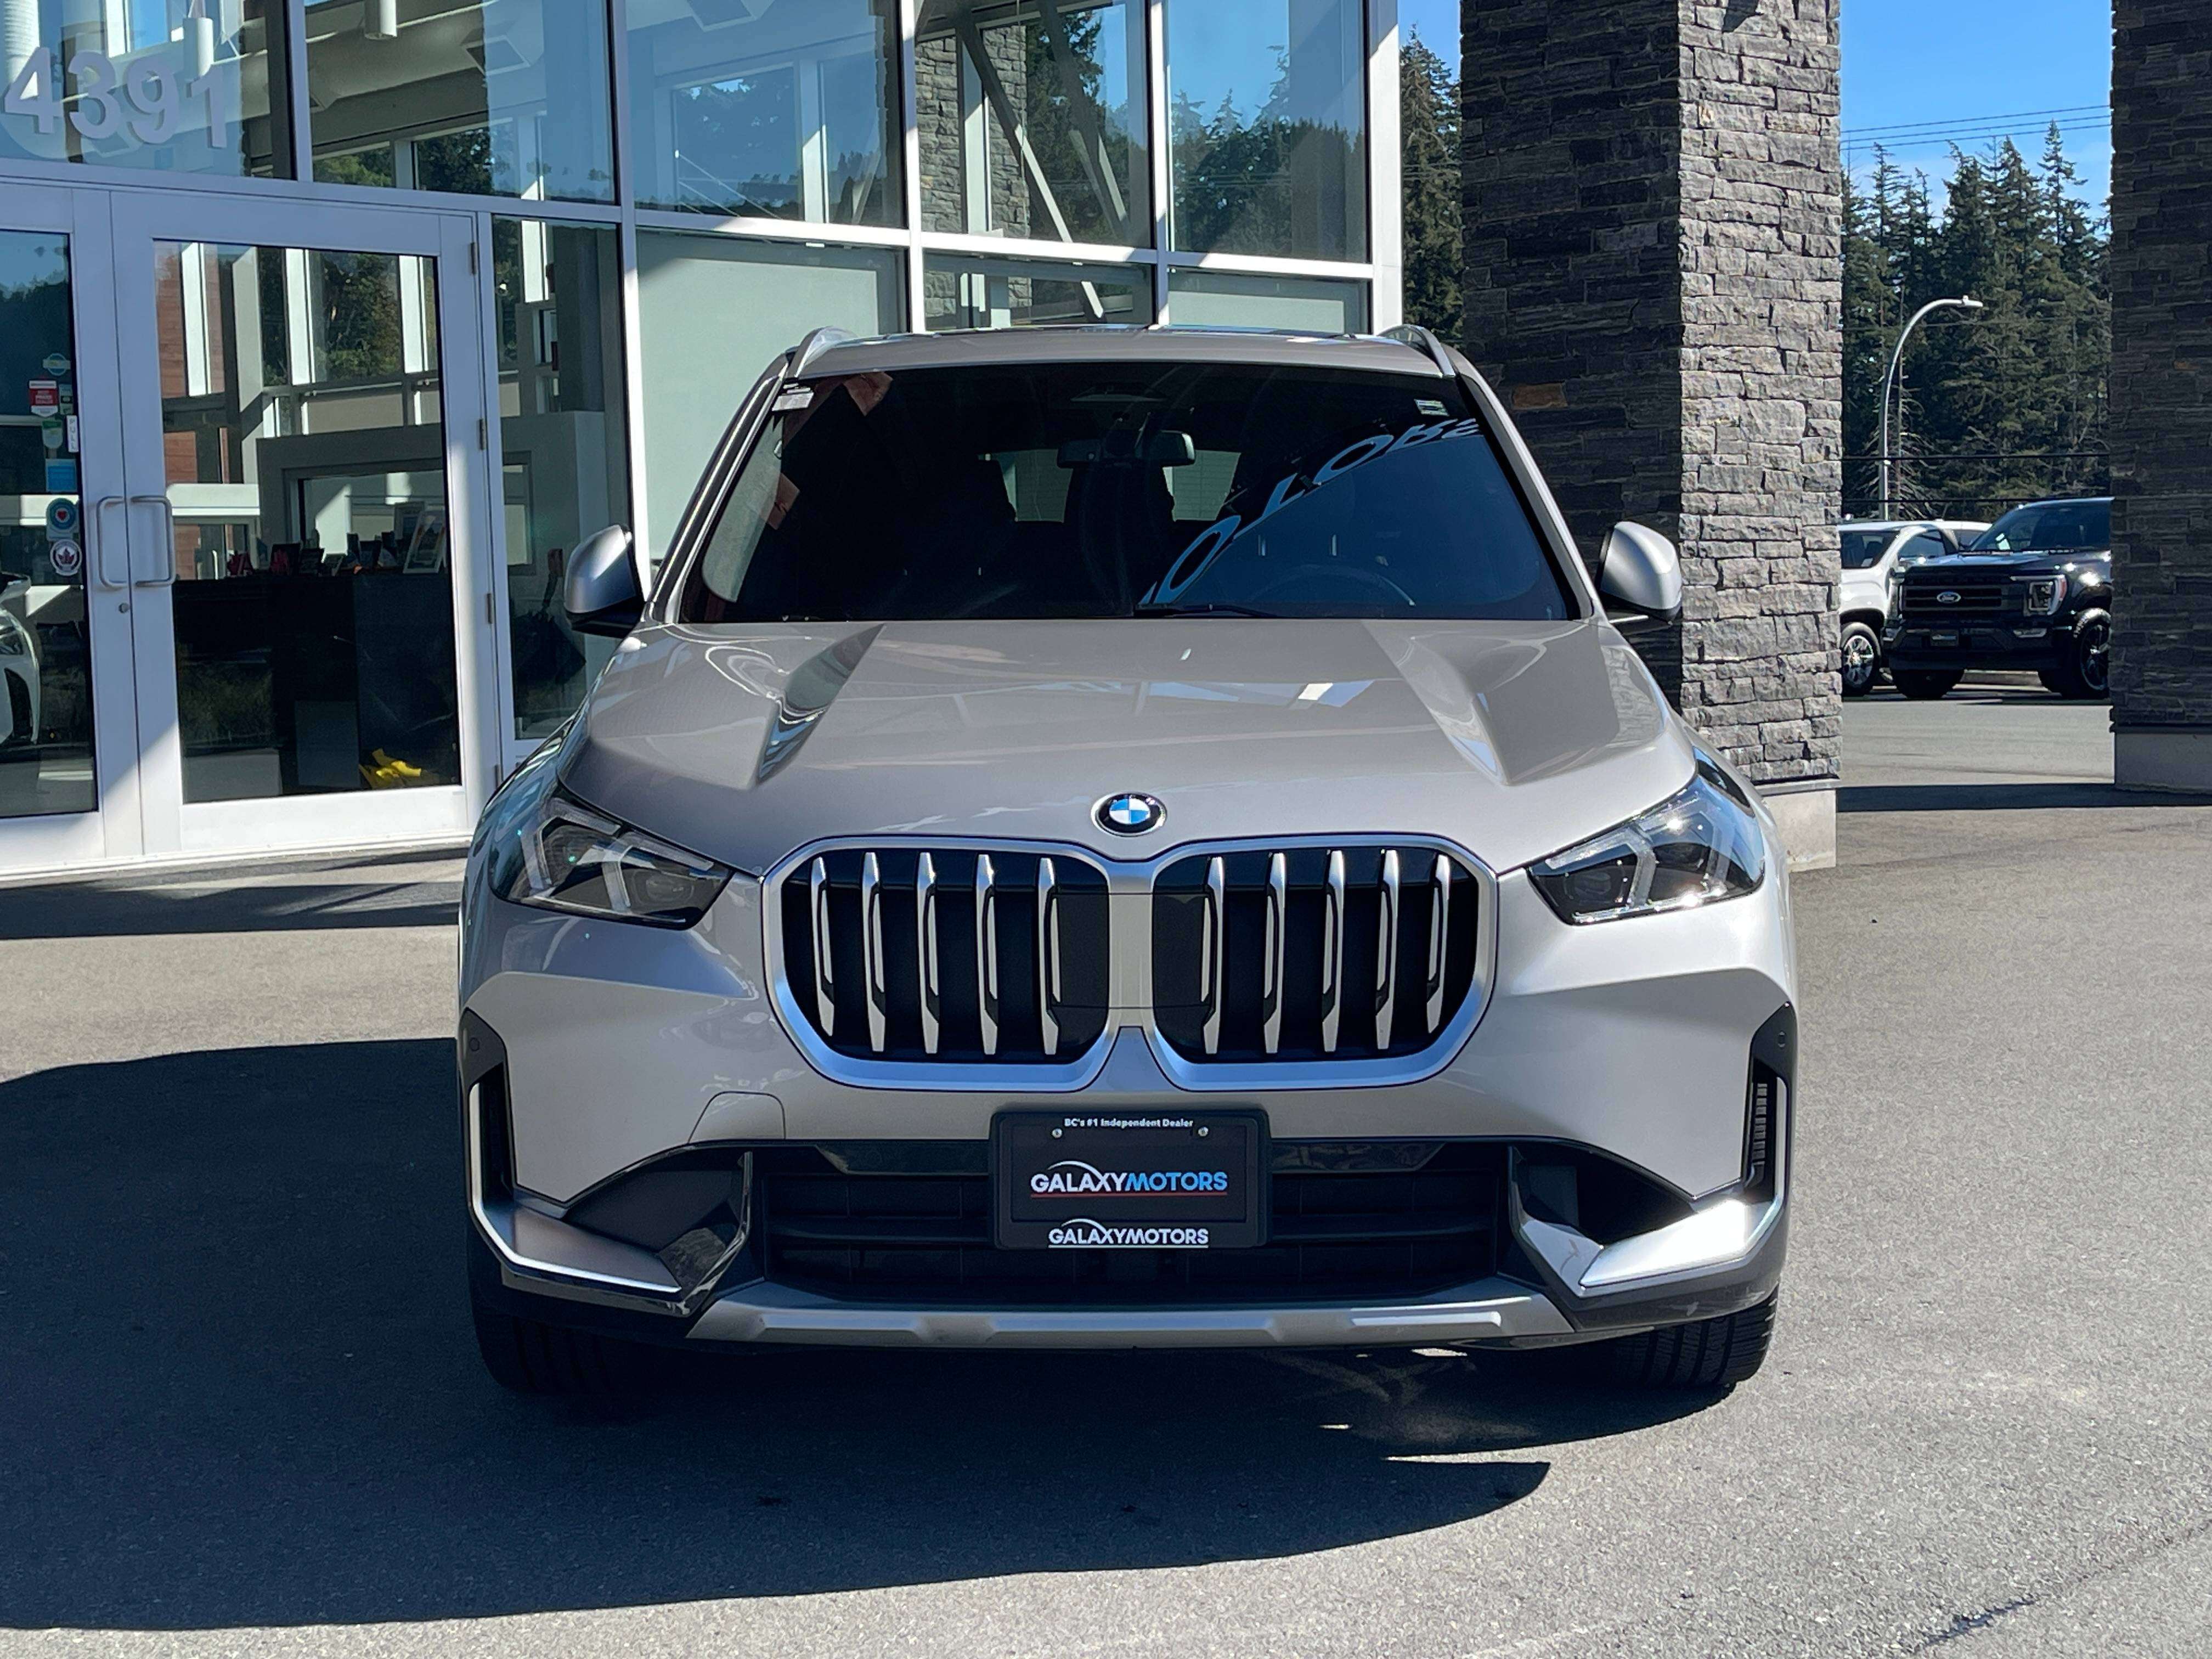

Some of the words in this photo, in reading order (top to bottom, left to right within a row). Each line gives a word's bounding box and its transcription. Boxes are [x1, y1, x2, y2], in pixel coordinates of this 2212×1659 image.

[3, 46, 228, 148] 4391
[1064, 1118, 1085, 1127] BC's
[1087, 1118, 1098, 1127] #1
[1101, 1118, 1160, 1129] Independent
[1163, 1119, 1193, 1127] Dealer
